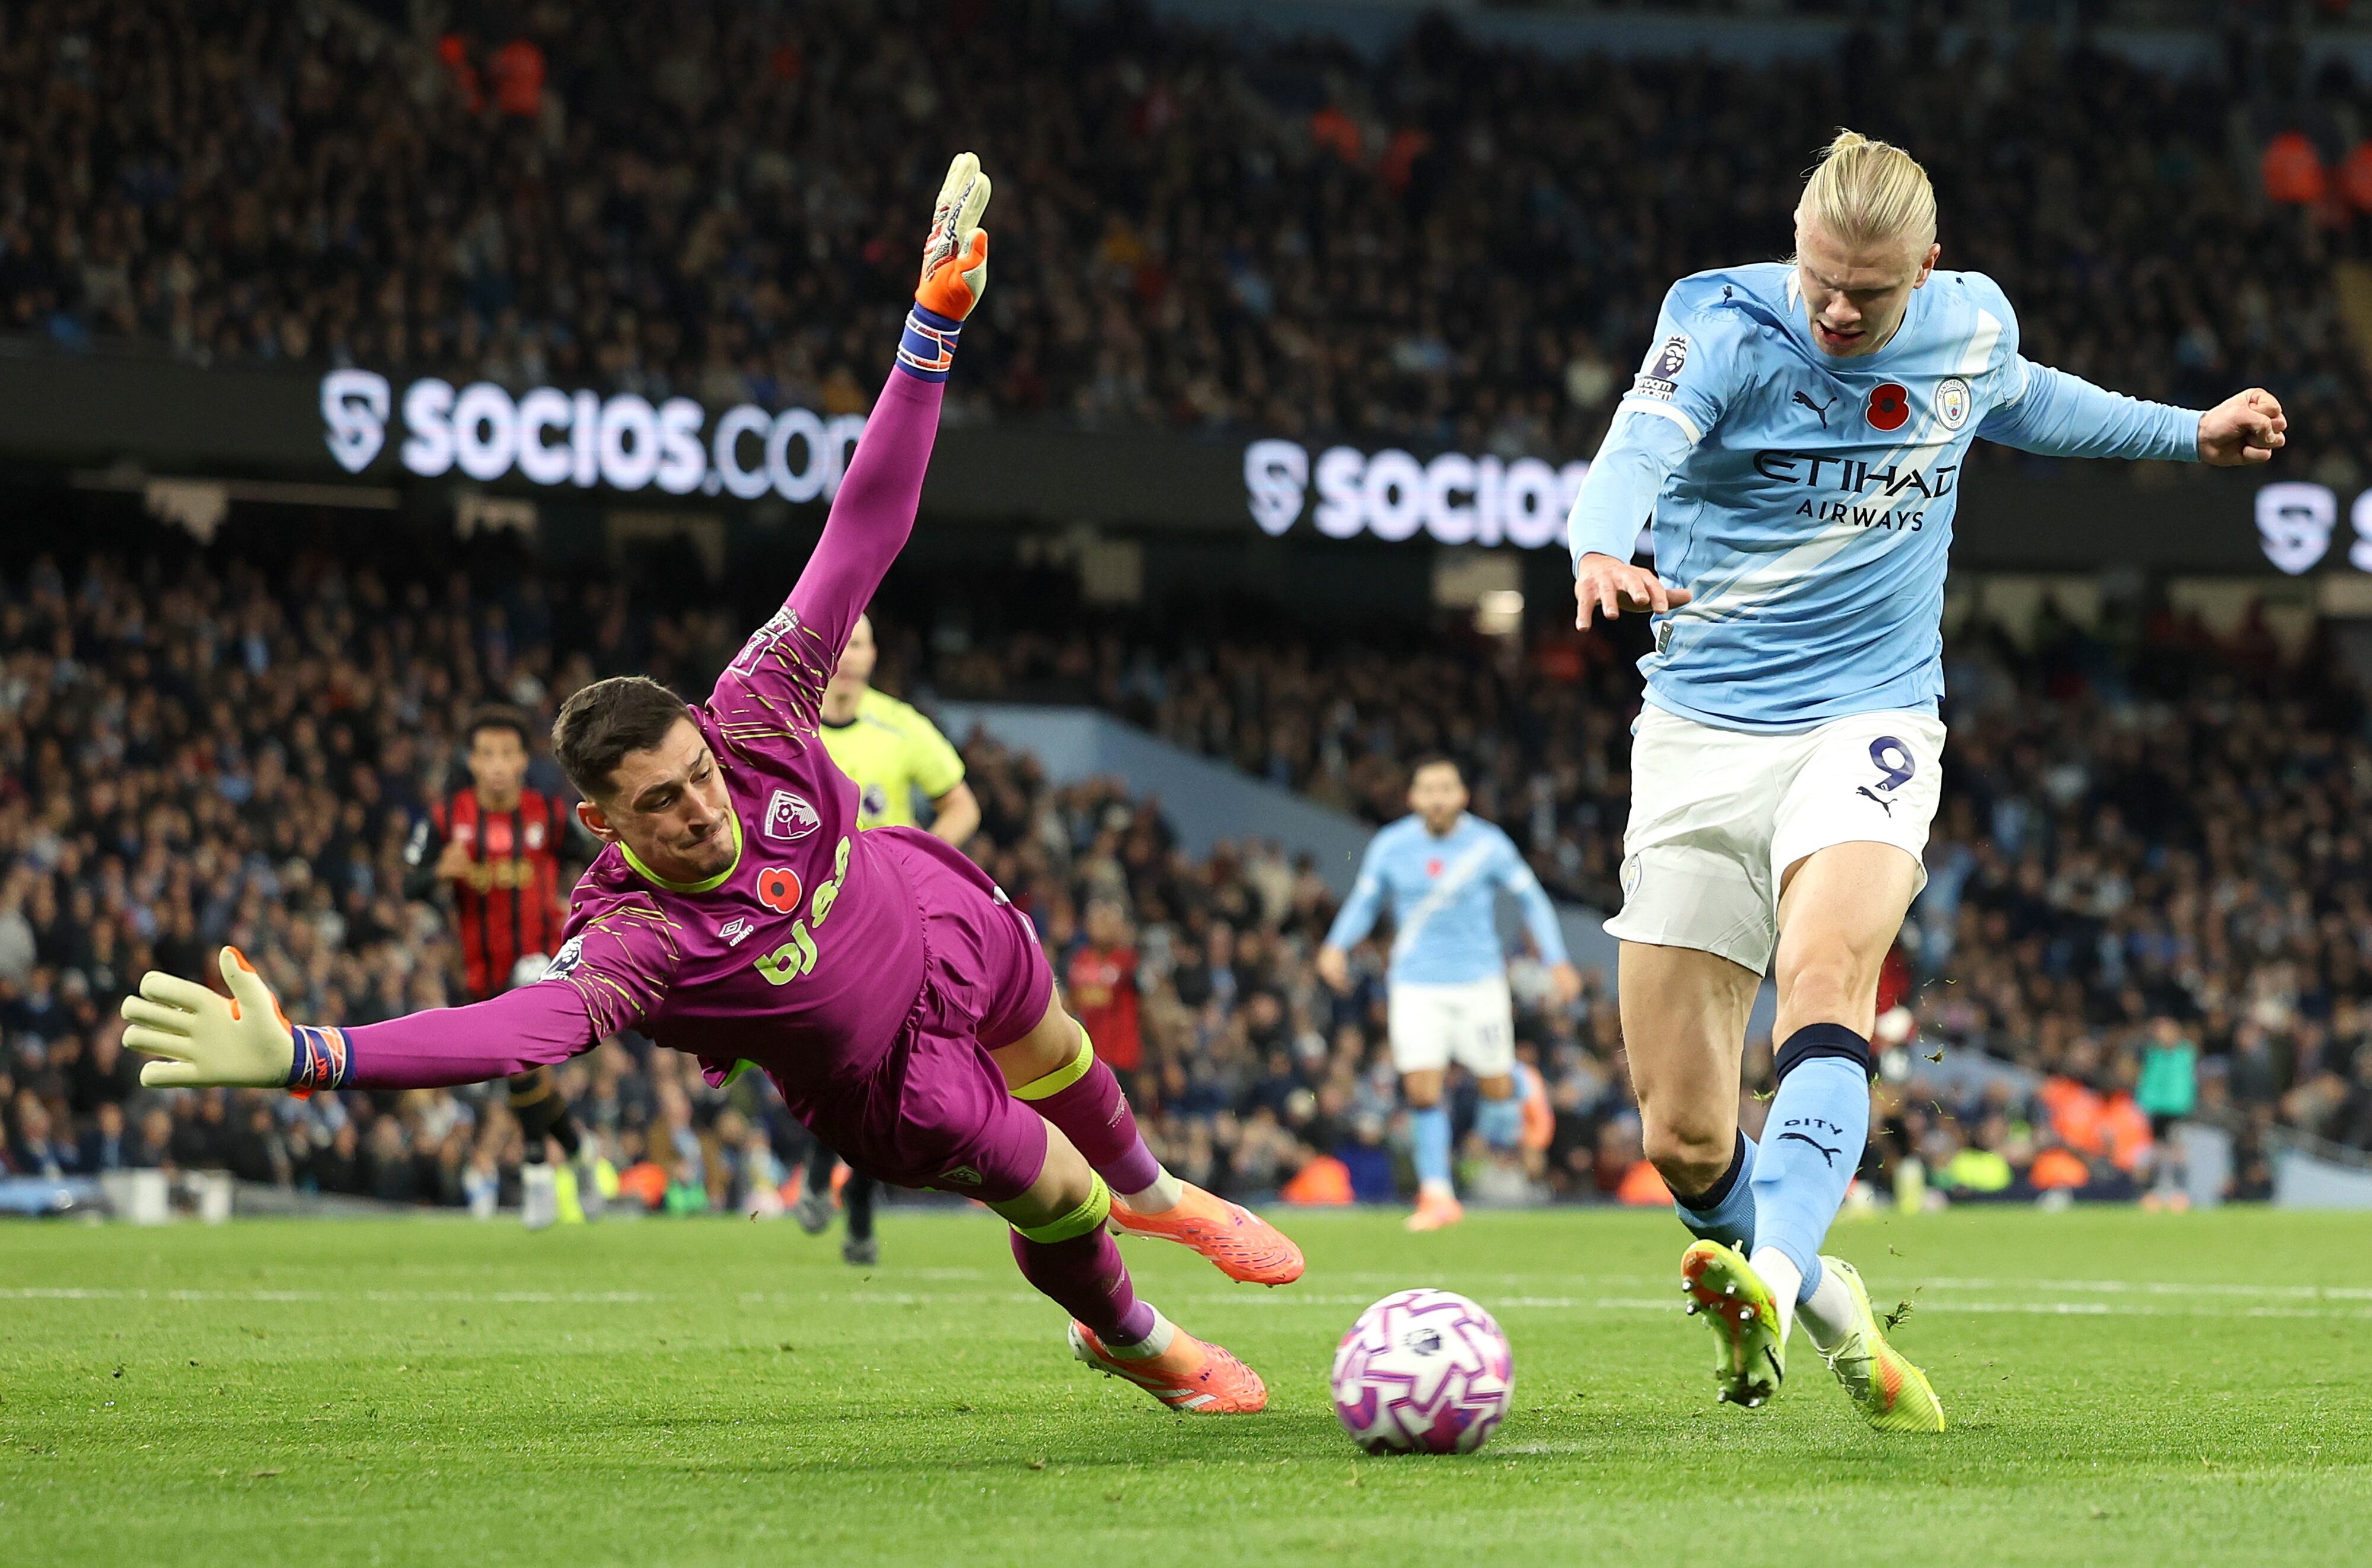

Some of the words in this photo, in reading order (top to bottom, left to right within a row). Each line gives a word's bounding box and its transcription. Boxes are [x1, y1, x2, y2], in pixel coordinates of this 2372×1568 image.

[1939, 380, 1967, 400] MANCHESTER
[1753, 449, 1957, 499] ETIHAD
[1796, 498, 1924, 532] AIRWAYS
[1869, 736, 1916, 792] 9
[729, 924, 754, 947] umbro
